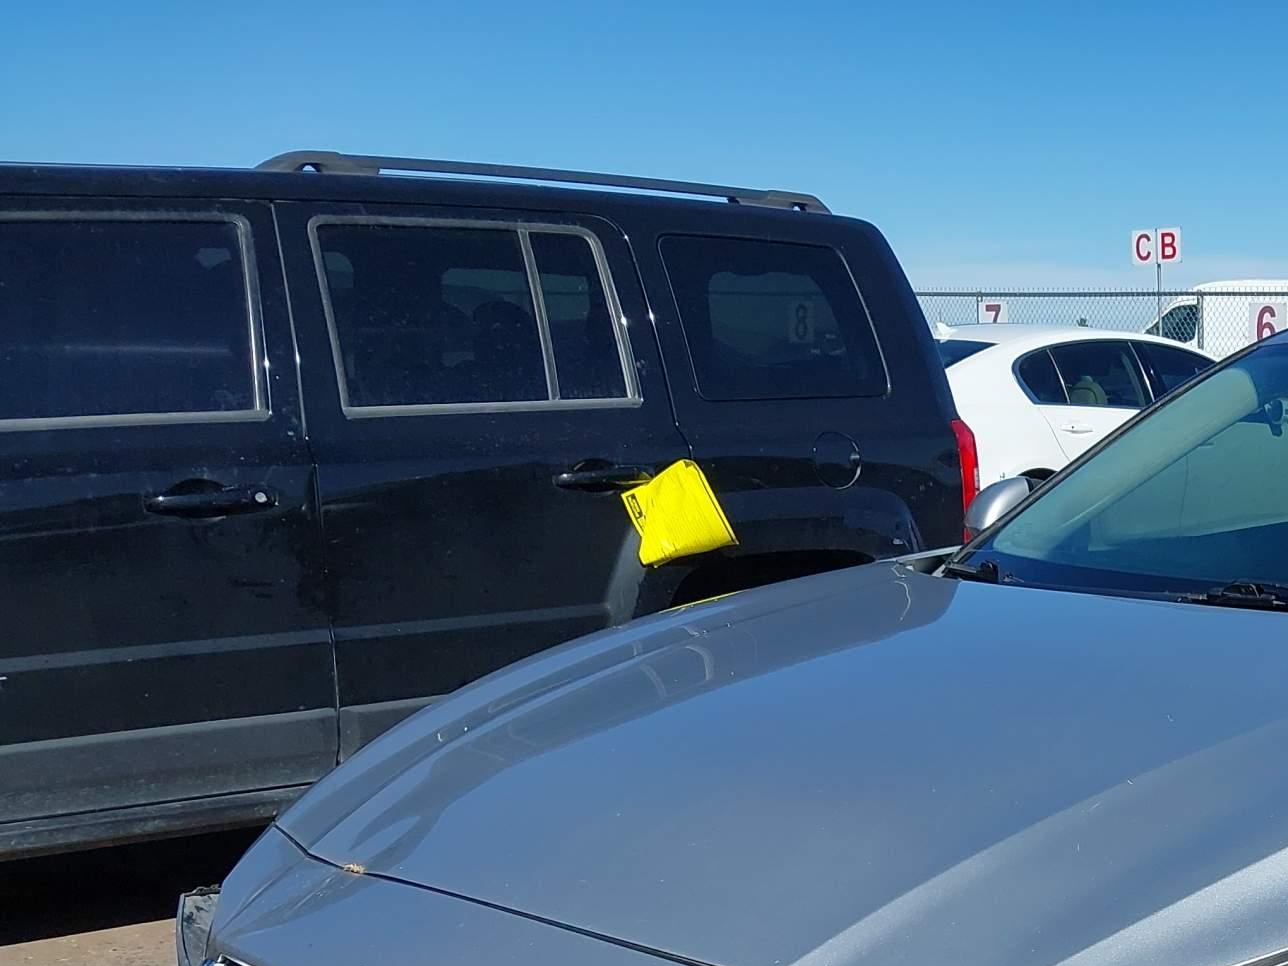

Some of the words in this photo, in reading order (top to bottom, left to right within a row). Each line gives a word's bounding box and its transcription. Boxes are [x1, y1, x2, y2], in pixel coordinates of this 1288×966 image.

[1136, 234, 1151, 261] C
[1161, 233, 1177, 259] B
[985, 304, 1002, 324] 7
[1257, 305, 1277, 338] 6
